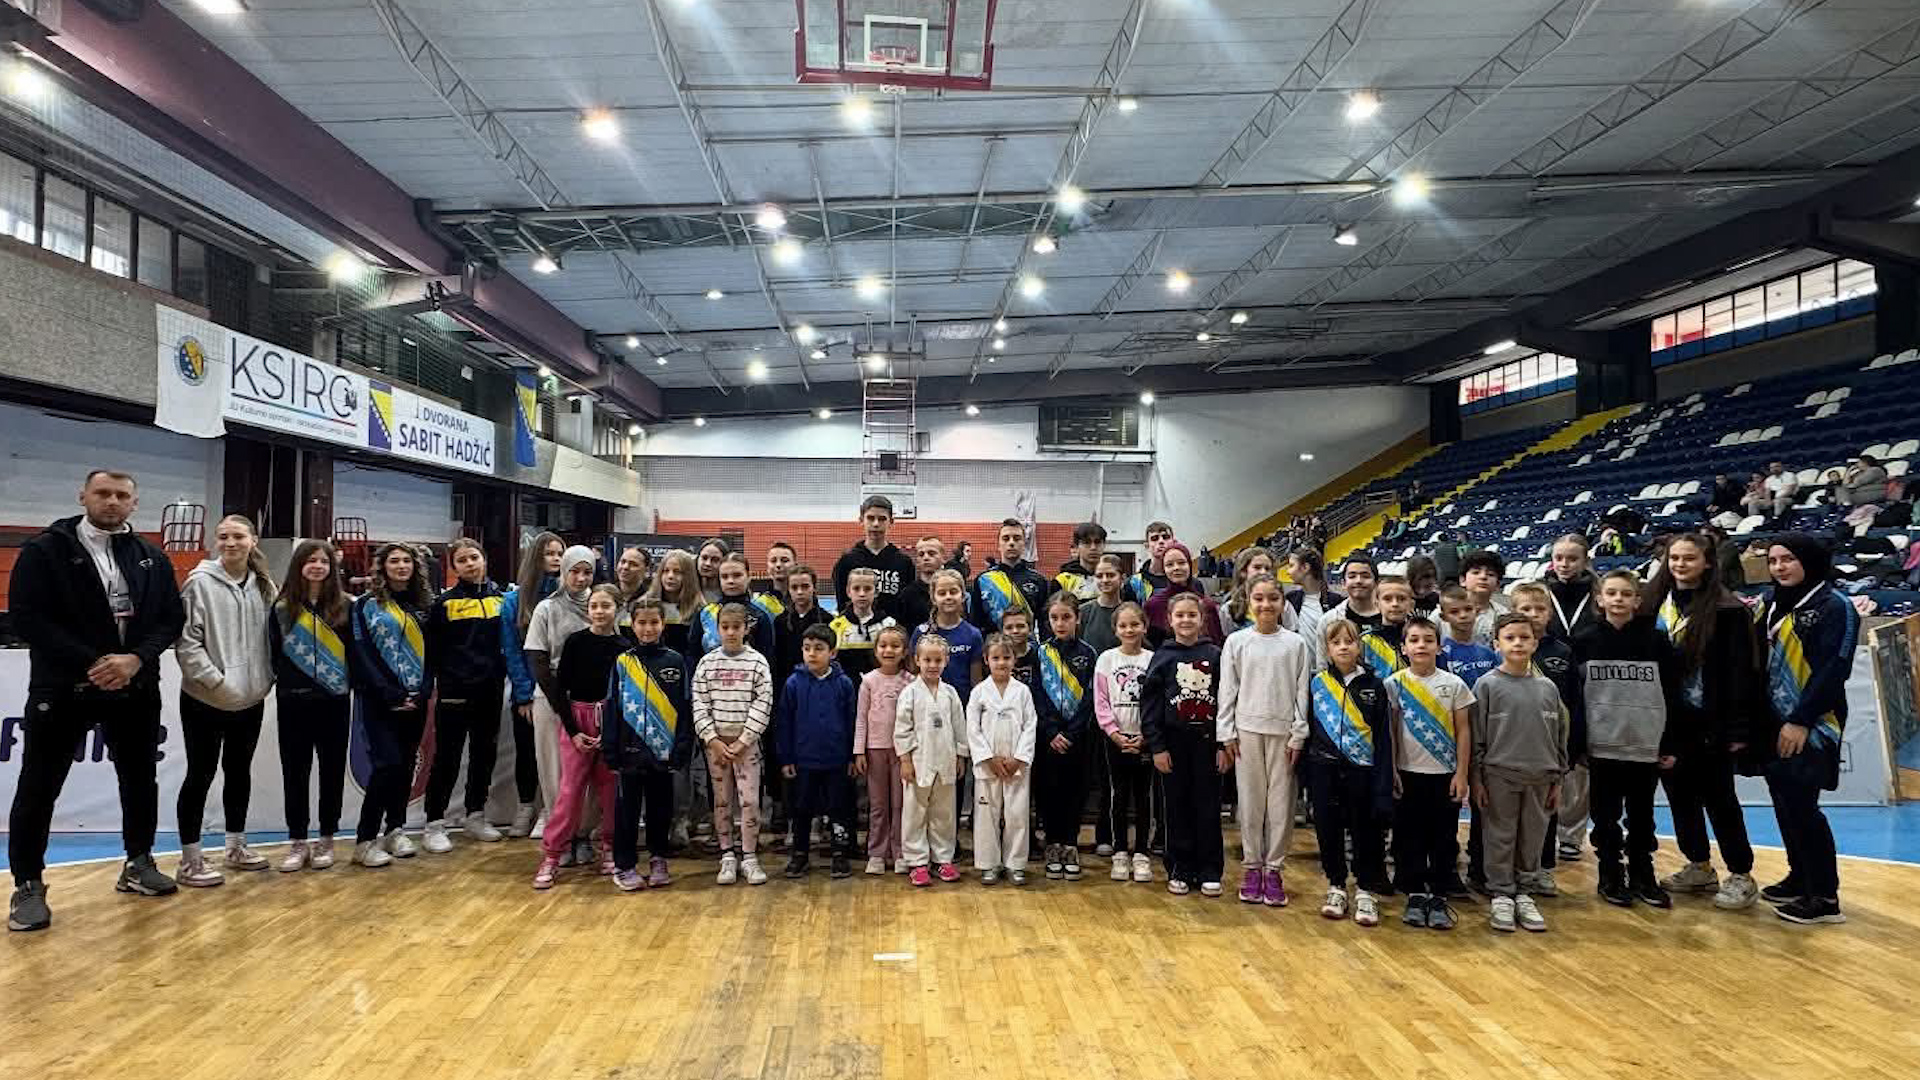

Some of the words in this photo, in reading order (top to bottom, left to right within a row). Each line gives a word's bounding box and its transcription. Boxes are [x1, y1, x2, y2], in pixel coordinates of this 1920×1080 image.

[231, 336, 353, 418] KSIRC
[424, 407, 469, 434] DVORANA
[399, 423, 442, 456] SABIT
[445, 436, 491, 468] HADŽIĆ
[1590, 664, 1654, 682] BULLDOGS
